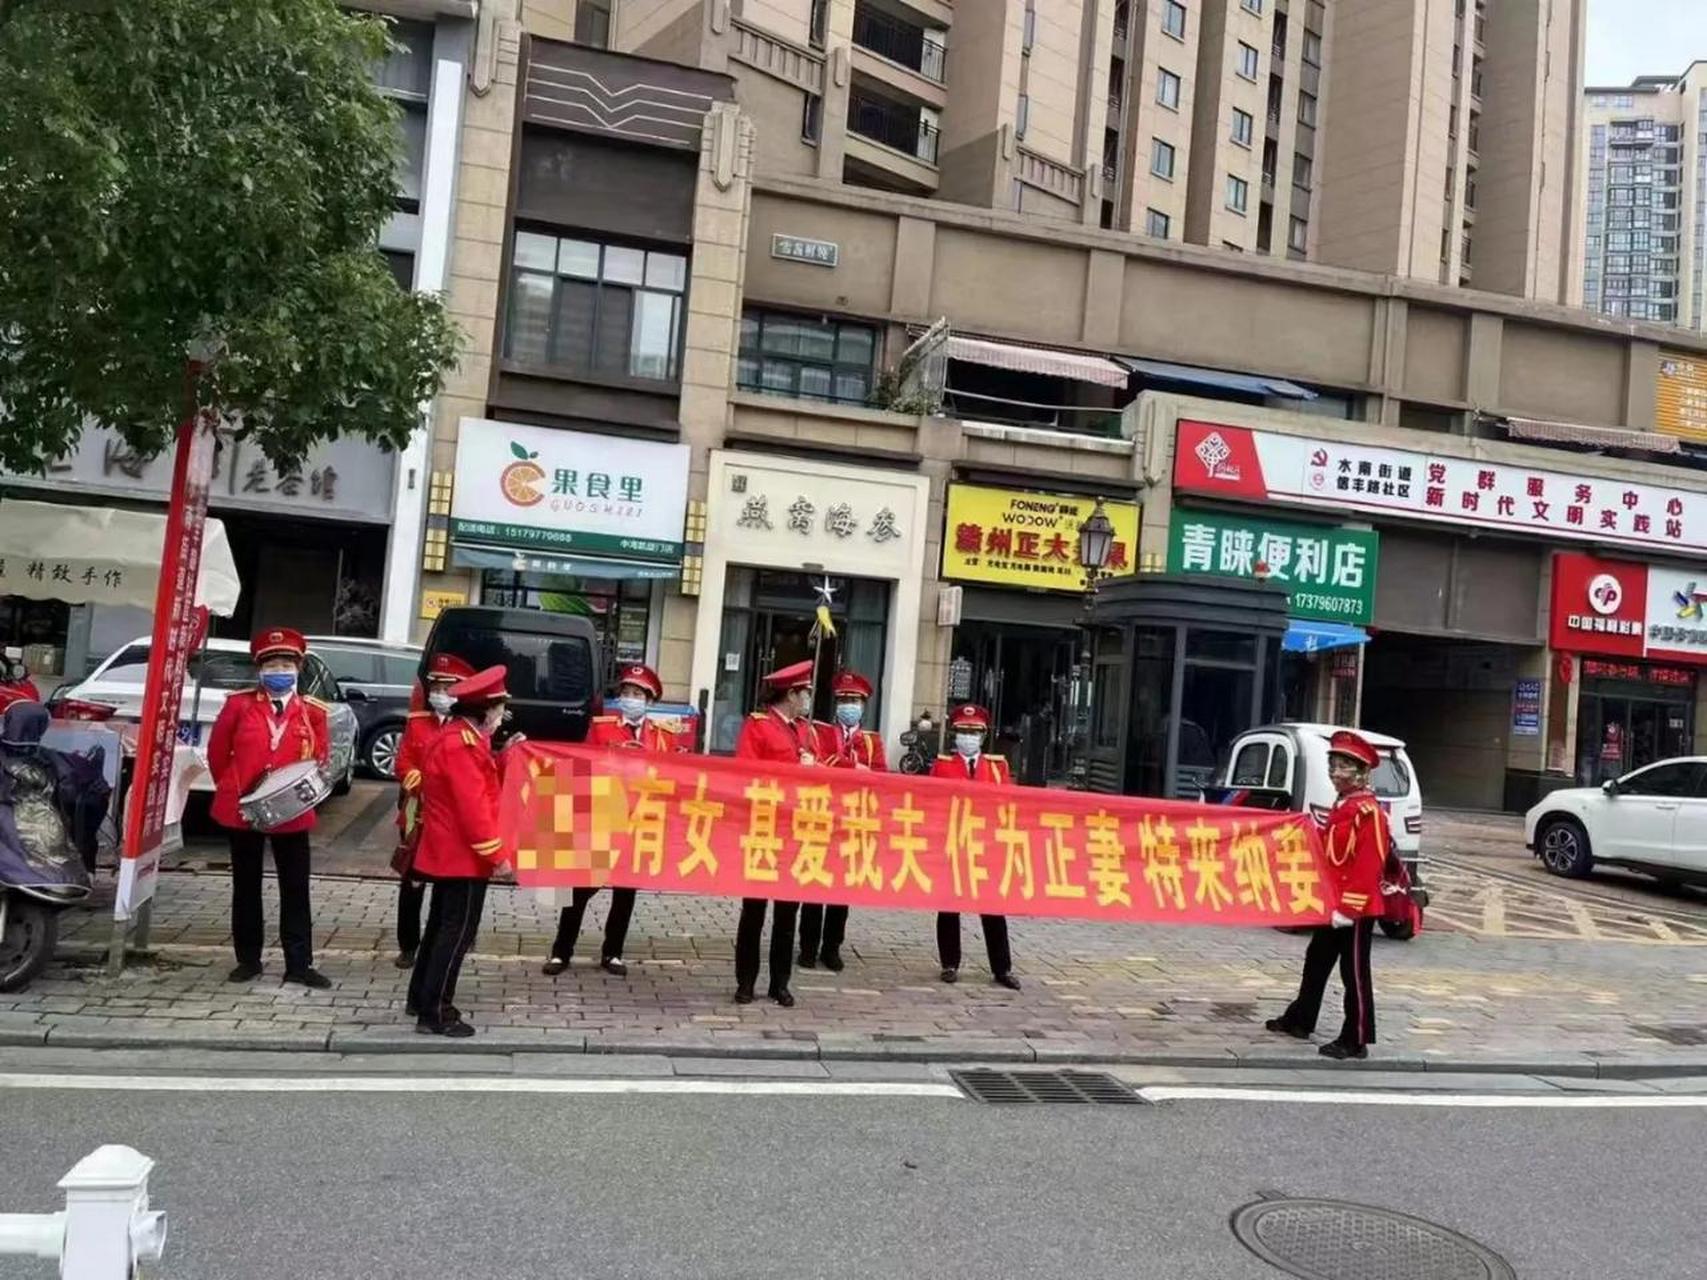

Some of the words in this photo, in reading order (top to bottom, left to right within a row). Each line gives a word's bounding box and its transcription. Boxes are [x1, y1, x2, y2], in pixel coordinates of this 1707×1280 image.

[552, 467, 643, 503] 果食里
[1338, 458, 1412, 481] 水南街道
[1427, 463, 1683, 517] 党群服务中心
[1425, 486, 1682, 539] 新时代文明实践站
[1181, 523, 1367, 588] 青睐便利店
[1295, 593, 1363, 615] 17379607873
